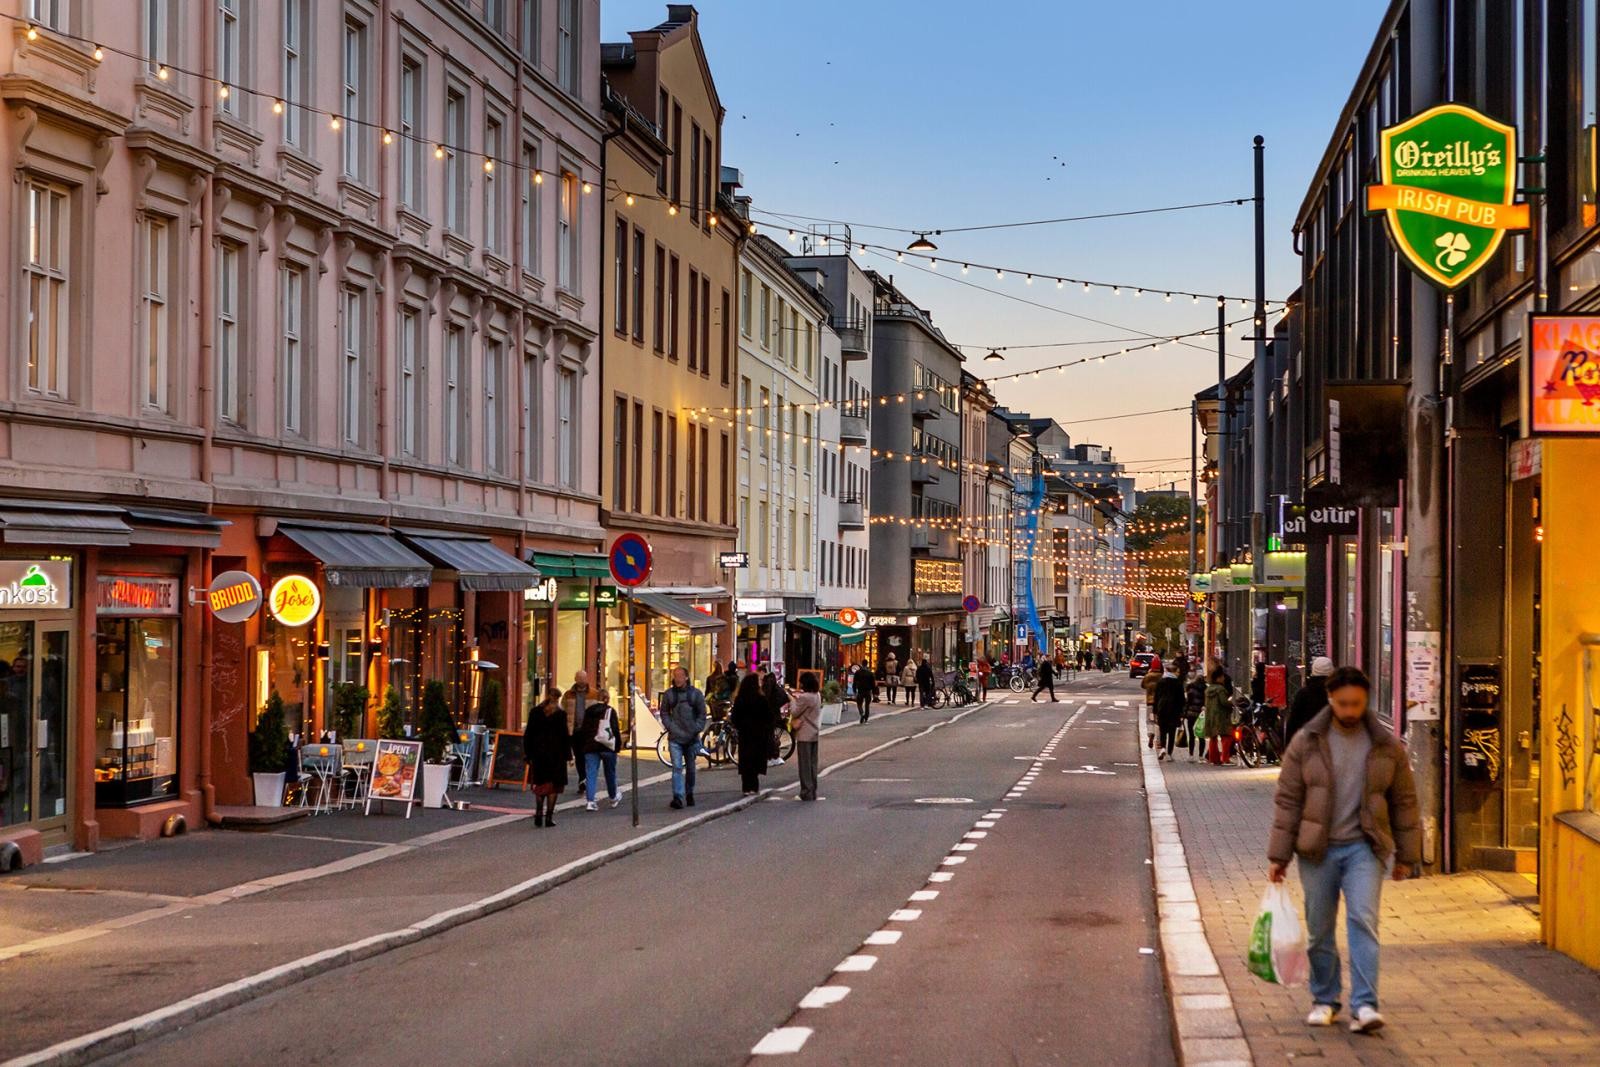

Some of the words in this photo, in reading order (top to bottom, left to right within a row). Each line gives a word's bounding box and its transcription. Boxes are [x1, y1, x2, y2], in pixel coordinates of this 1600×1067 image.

[1396, 169, 1437, 177] DRINKING
[1438, 168, 1471, 176] HEAVEN
[1397, 189, 1452, 216] IRISH
[1455, 201, 1497, 225] PUB
[0, 581, 58, 605] nkost
